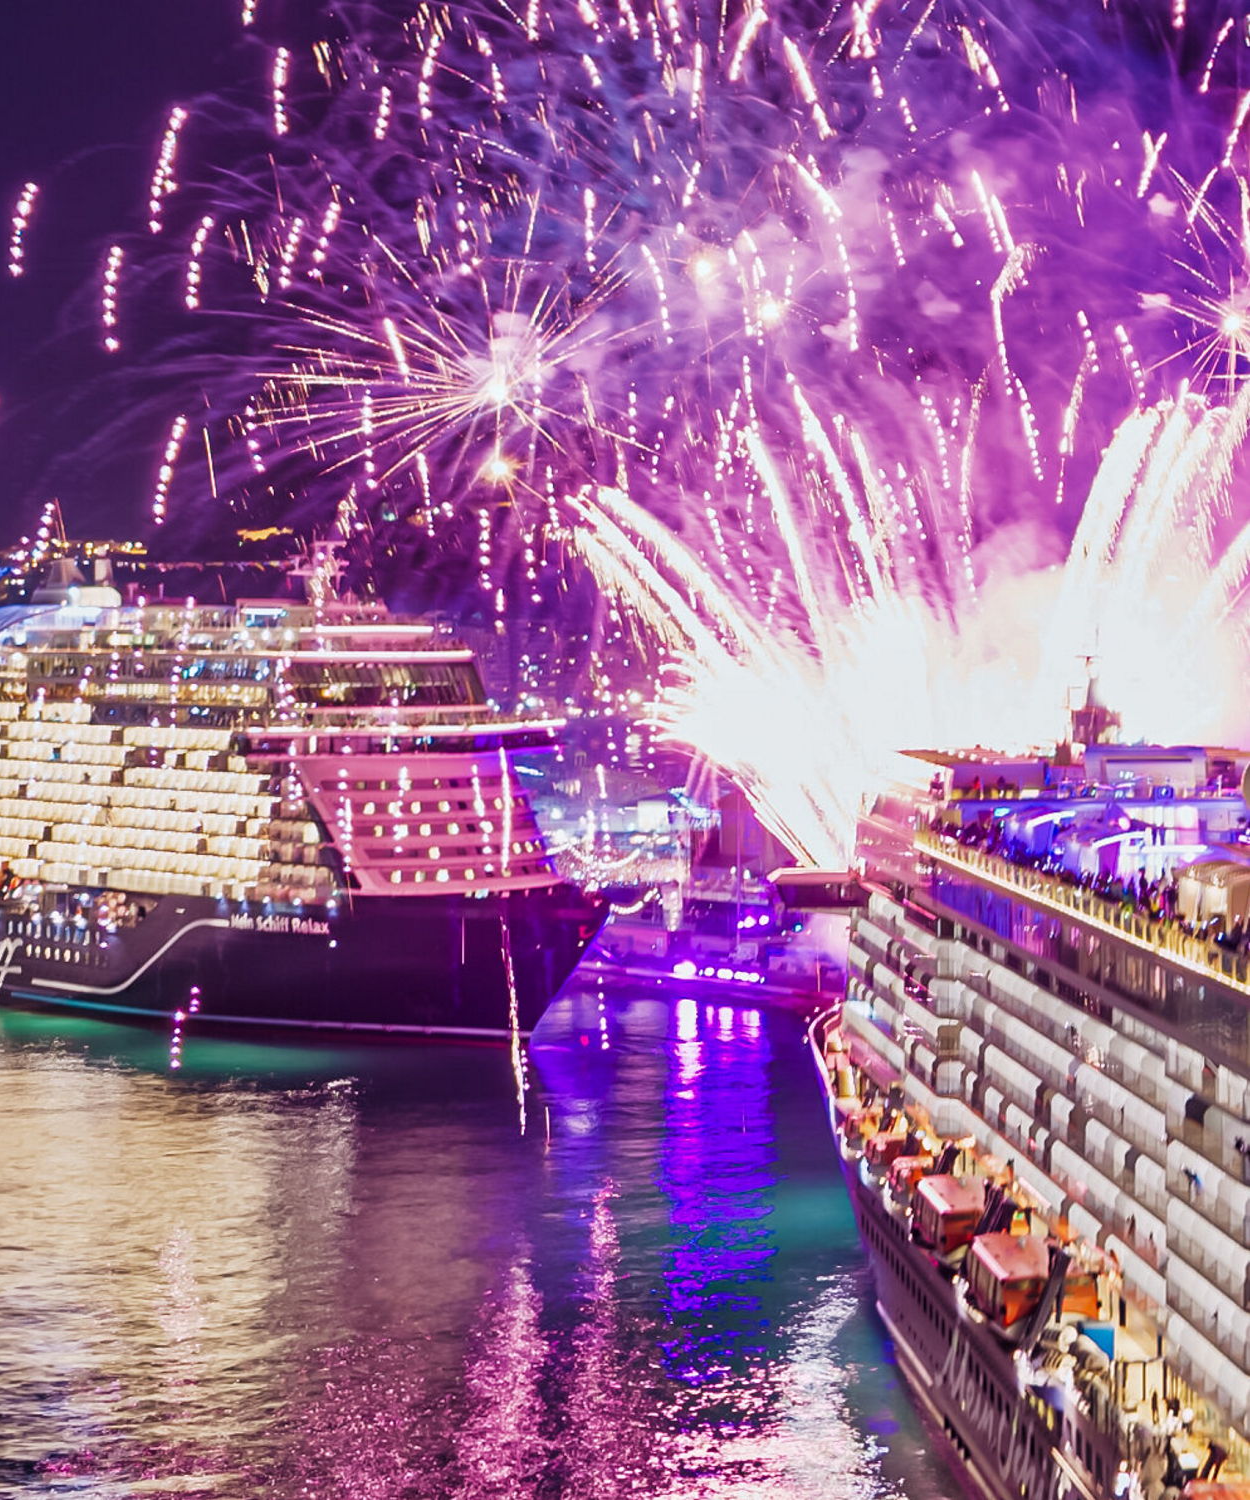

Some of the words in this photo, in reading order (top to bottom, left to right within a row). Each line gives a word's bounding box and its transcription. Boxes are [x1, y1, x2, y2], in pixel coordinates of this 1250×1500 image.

[255, 914, 289, 933] Schiff
[291, 917, 330, 935] Relax
[934, 1326, 997, 1446] Mein
